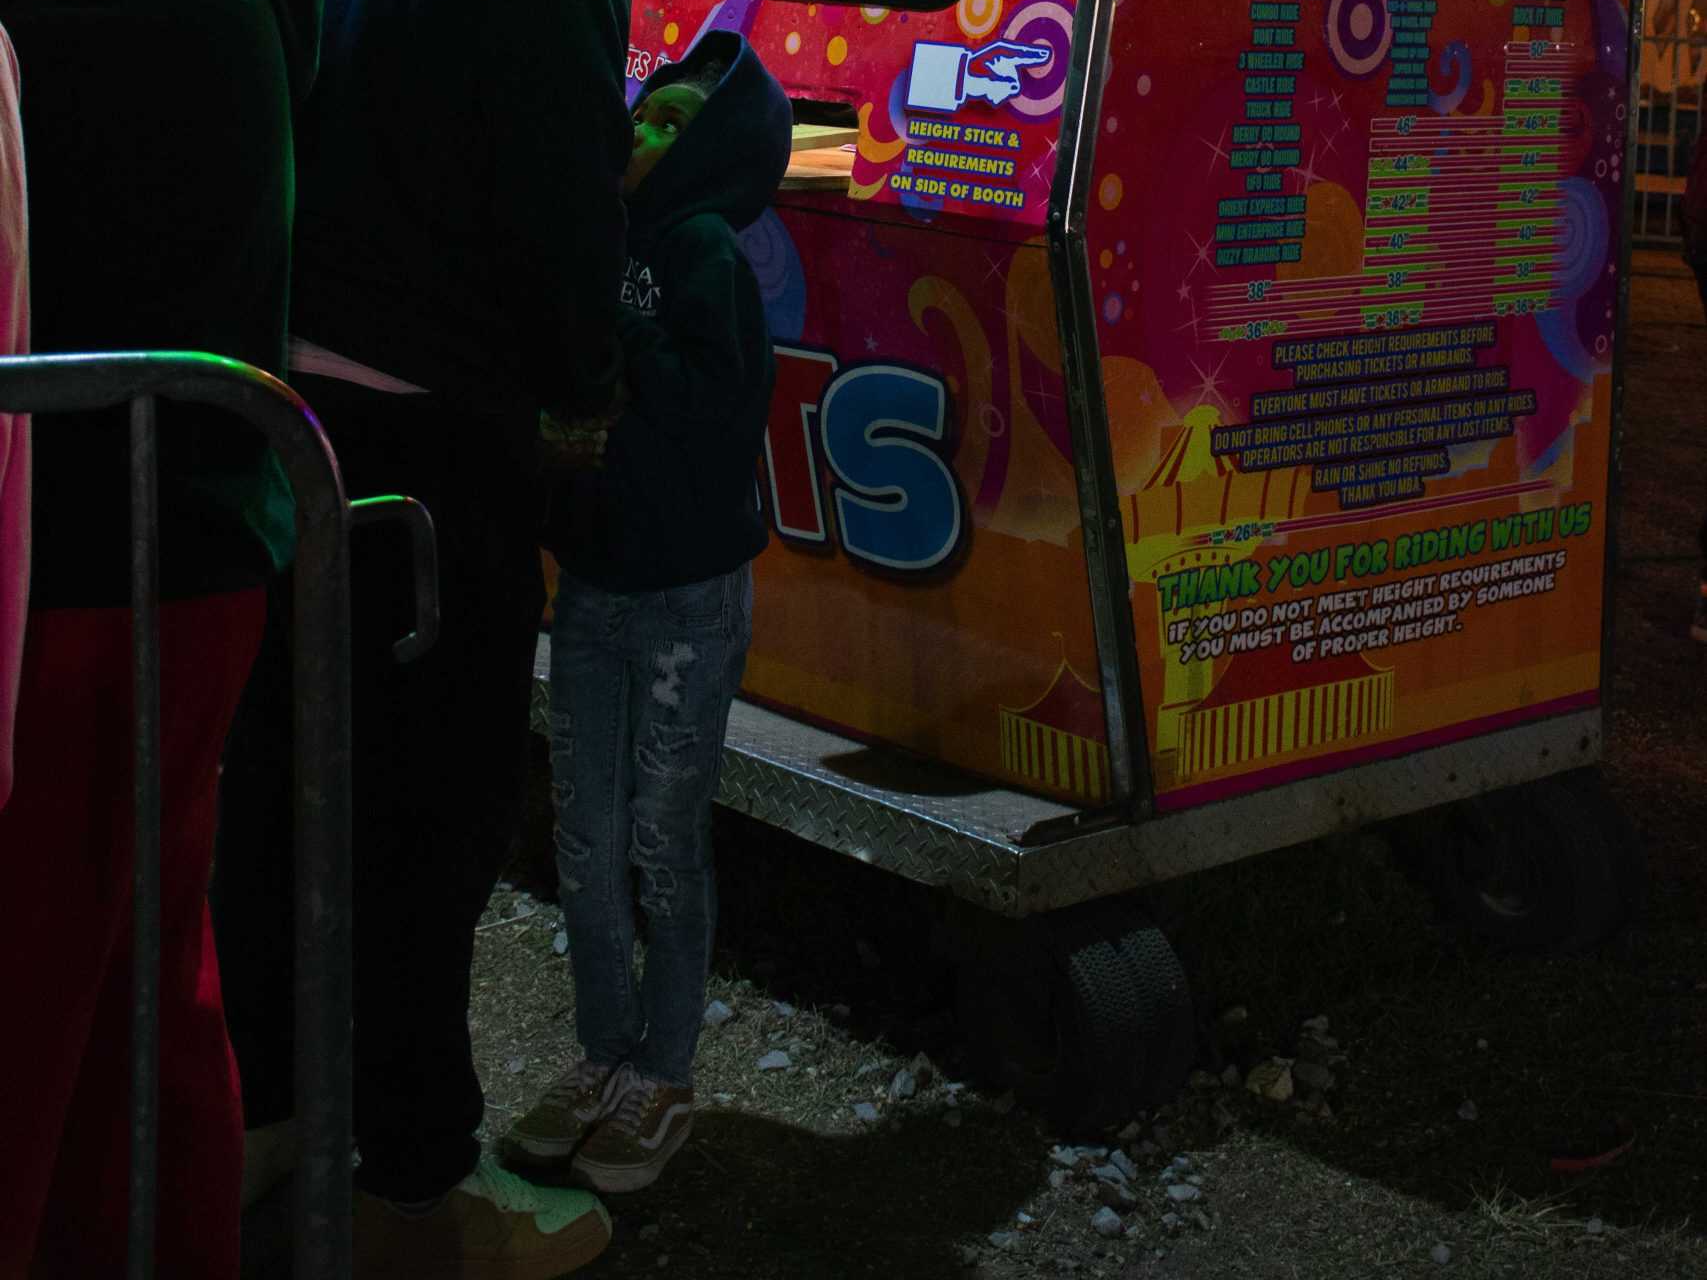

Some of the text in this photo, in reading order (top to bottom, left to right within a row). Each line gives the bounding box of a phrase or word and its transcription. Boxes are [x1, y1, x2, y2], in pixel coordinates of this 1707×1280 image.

[909, 120, 1020, 147] HEIGHT STICK &
[906, 148, 1015, 176] REQUIREMENTS
[890, 175, 1024, 208] ON SIDE OF BOOTH
[1248, 281, 1272, 299] 38"
[1275, 343, 1313, 364] PLEASE
[1316, 339, 1350, 359] CHECK
[1352, 336, 1386, 355] HEIGHT
[1388, 329, 1459, 352] REQUIREMENTS
[1296, 360, 1360, 381] PURCHASING
[1364, 354, 1404, 375] TICKETS
[1405, 352, 1418, 369] OR
[1253, 393, 1307, 416] EVERYONE
[1310, 390, 1339, 408] MUST
[1340, 387, 1366, 405] HAVE
[1369, 382, 1408, 401] TICKETS
[1410, 381, 1423, 397] OR
[1424, 375, 1471, 395] ARMBAND
[1472, 373, 1485, 388] TO
[1215, 432, 1229, 449] DO
[1231, 429, 1252, 448] NOT
[1255, 426, 1287, 446] BRING
[1289, 422, 1312, 441] CELL
[1314, 416, 1354, 437] PHONES
[1357, 415, 1370, 432] OR
[1373, 412, 1393, 429] ANY
[1394, 407, 1441, 426] PERSONAL
[1444, 402, 1472, 420] ITEMS
[1474, 400, 1486, 416] ON
[1487, 399, 1505, 415] ANY
[1243, 444, 1304, 466] OPERATORS
[1305, 441, 1327, 458] ARE
[1328, 437, 1348, 456] NOT
[1350, 430, 1415, 453] RESPONSIBLE
[1417, 427, 1438, 444] FOR
[1439, 424, 1456, 441] ANY
[1458, 420, 1480, 438] LOST
[1315, 467, 1340, 487] RAIN
[1342, 464, 1356, 482] OR
[1360, 460, 1388, 481] SHINE
[1389, 457, 1401, 474] NO
[1342, 483, 1375, 503] THANK
[1380, 480, 1396, 497] YOU
[1158, 560, 1260, 611] THANK
[1268, 549, 1329, 593] YOU
[1335, 541, 1388, 580] FOR
[1559, 502, 1591, 537] US
[1180, 640, 1224, 664] YOU
[1229, 626, 1285, 653] MUST
[1289, 622, 1314, 641] BE
[1448, 591, 1473, 610] BY
[1476, 573, 1556, 606] SOMEONE
[1192, 612, 1236, 637] YOU
[1241, 607, 1267, 628] DO
[1271, 599, 1312, 621] NOT
[1317, 589, 1368, 613] MEET
[1291, 643, 1316, 663] OF
[1319, 626, 1390, 658] PROPER
